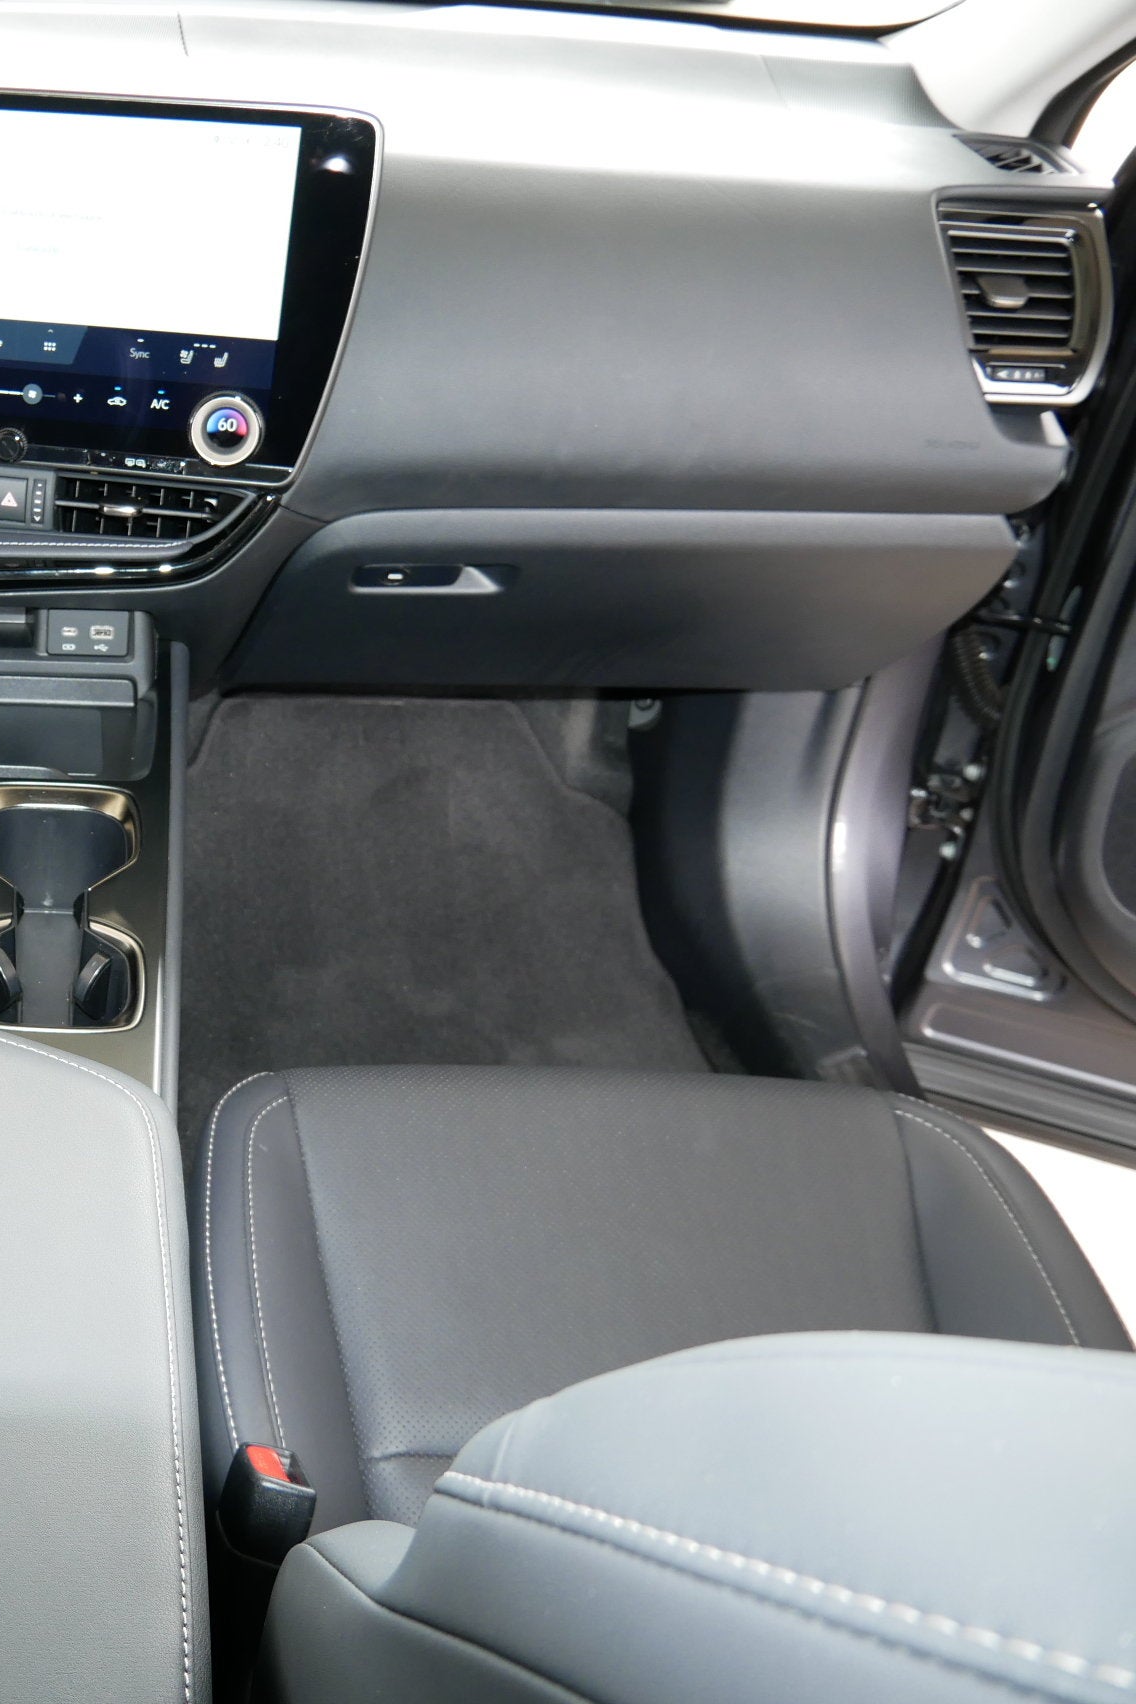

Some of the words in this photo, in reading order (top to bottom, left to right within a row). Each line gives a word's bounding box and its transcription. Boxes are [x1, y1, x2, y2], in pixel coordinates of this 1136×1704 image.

[129, 347, 151, 360] Sync
[150, 398, 171, 410] A/C
[217, 417, 238, 432] 60
